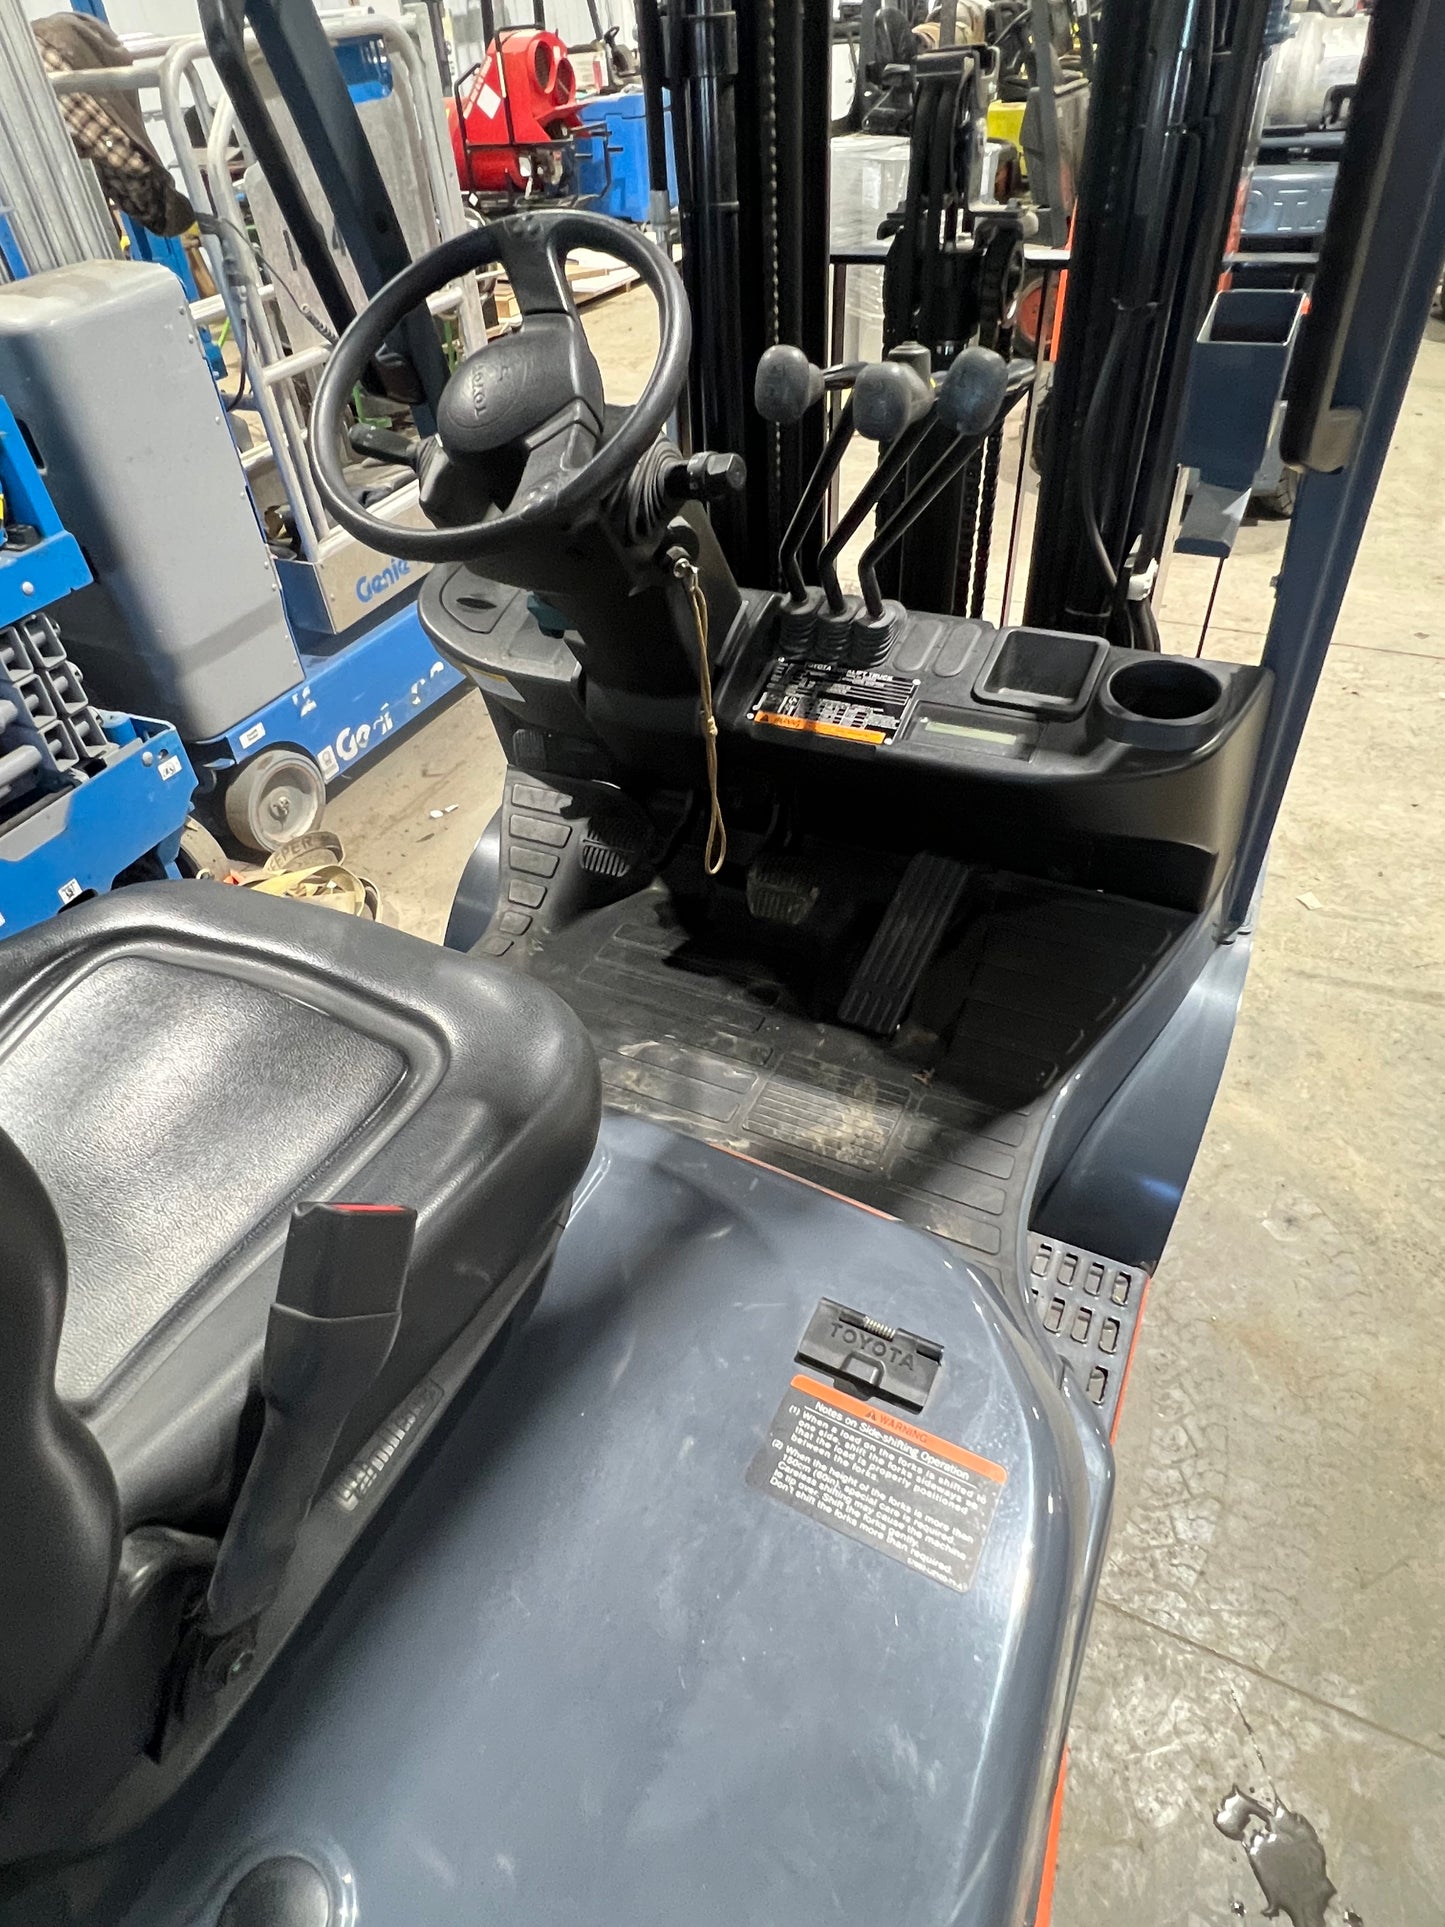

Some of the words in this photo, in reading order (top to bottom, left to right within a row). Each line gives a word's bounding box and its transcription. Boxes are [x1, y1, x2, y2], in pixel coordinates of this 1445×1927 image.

[356, 555, 411, 603] Genie
[804, 662, 832, 672] OYOTA
[831, 1322, 913, 1371] TOYOTA
[787, 1404, 801, 1416] (1)
[800, 1410, 829, 1429] When
[839, 1429, 862, 1444] load
[862, 1441, 877, 1452] on
[878, 1447, 896, 1461] the
[896, 1456, 924, 1474] forks
[925, 1470, 936, 1480] is
[936, 1475, 974, 1498] shifted
[974, 1493, 987, 1505] to
[790, 1432, 832, 1458] between
[832, 1453, 850, 1467] the
[797, 1419, 816, 1433] one
[843, 1440, 867, 1456] shift
[867, 1451, 886, 1465] the
[886, 1460, 914, 1479] forks
[914, 1474, 963, 1503] sideways
[814, 1401, 844, 1421] Notes
[843, 1416, 858, 1428] on
[857, 1421, 920, 1458] Side-shifting
[918, 1450, 971, 1482] Operation
[878, 1413, 928, 1443] WARNING
[770, 1437, 784, 1450] (2)
[784, 1444, 812, 1464] When
[811, 1458, 828, 1472] the
[827, 1466, 859, 1488] height
[857, 1481, 869, 1492] of
[869, 1487, 887, 1500] the
[886, 1495, 913, 1513] forks
[912, 1508, 924, 1518] is
[923, 1514, 951, 1532] more
[950, 1526, 975, 1543] than
[773, 1468, 784, 1479] to
[783, 1474, 797, 1486] tip
[820, 1492, 844, 1509] Shift
[843, 1504, 862, 1518] the
[861, 1512, 888, 1531] forks
[781, 1453, 812, 1473] 150cm
[842, 1484, 878, 1506] special
[877, 1501, 901, 1517] care
[901, 1513, 912, 1523] is
[793, 1425, 814, 1440] that
[814, 1435, 832, 1449] the
[832, 1444, 856, 1460] load
[856, 1456, 868, 1466] is
[867, 1462, 912, 1489] properly
[912, 1483, 969, 1516] positioned
[768, 1475, 795, 1494] Don't
[794, 1488, 817, 1505] shift
[815, 1499, 833, 1513] the
[833, 1508, 859, 1526] forks
[858, 1522, 885, 1539] more
[884, 1535, 910, 1552] than
[776, 1460, 818, 1486] Careless
[816, 1481, 853, 1504] shifting
[852, 1499, 875, 1515] may
[874, 1510, 906, 1530] cause
[905, 1524, 924, 1538] the
[923, 1534, 967, 1561] machine
